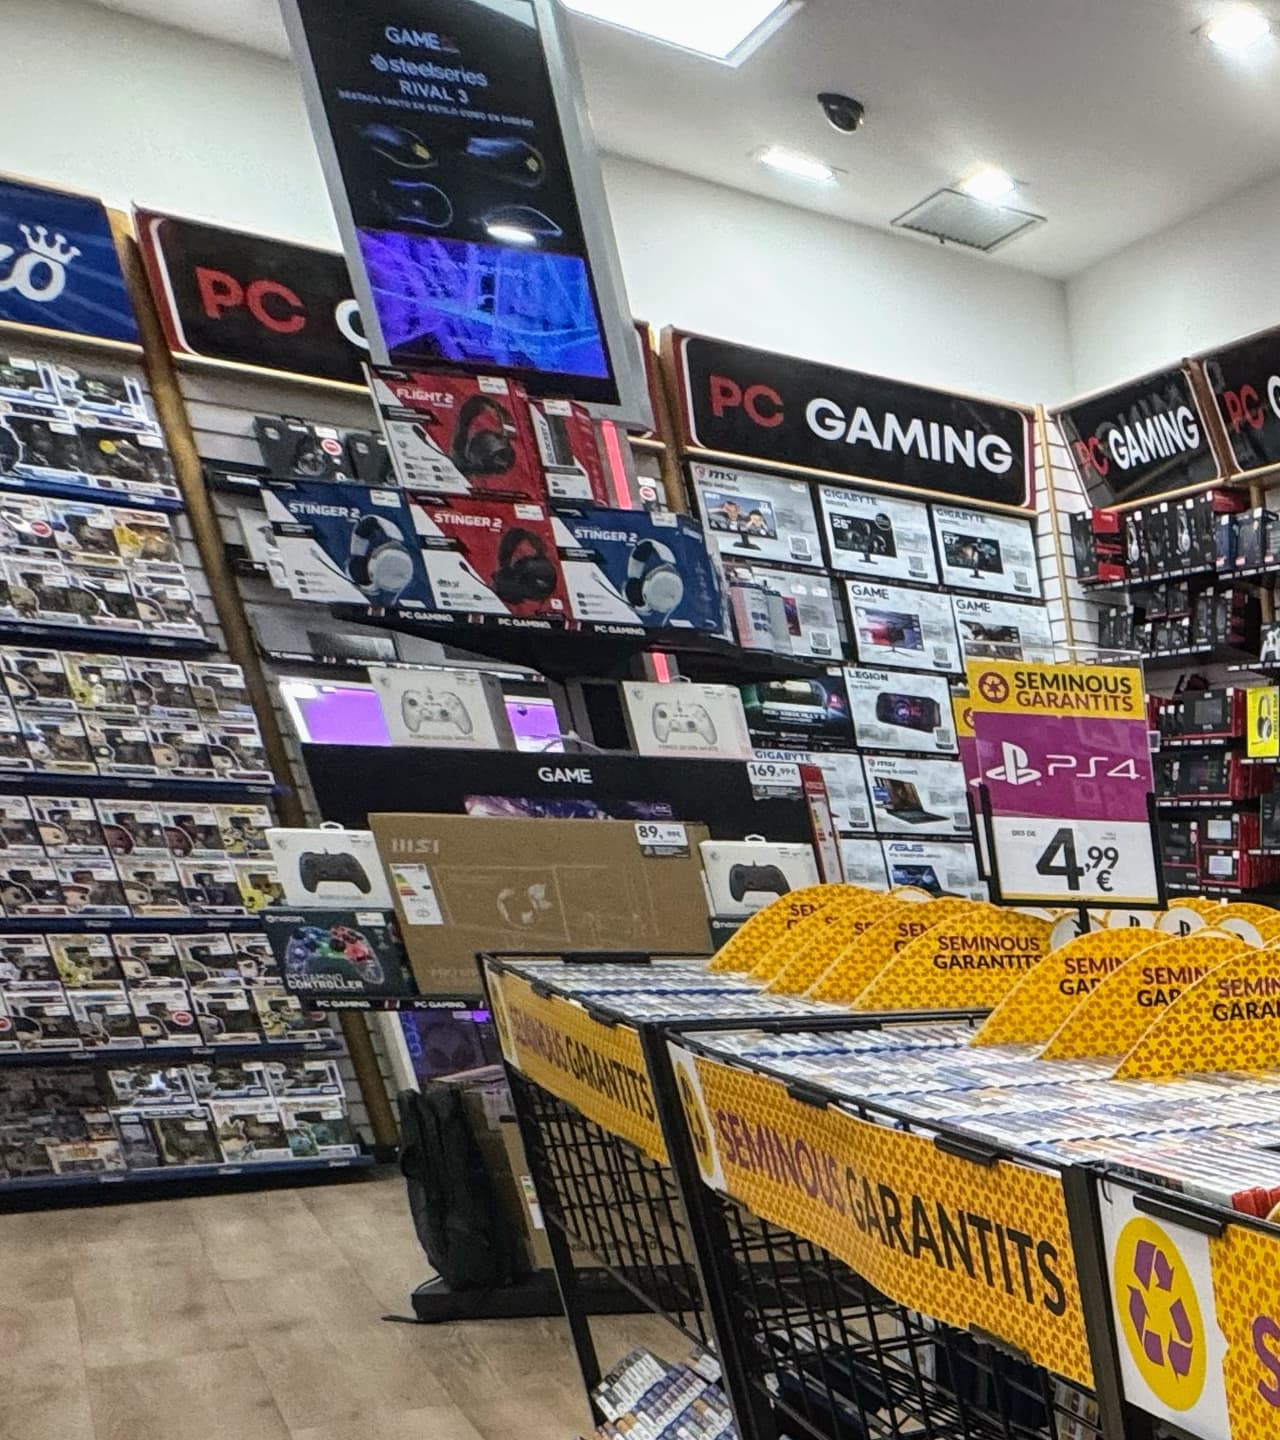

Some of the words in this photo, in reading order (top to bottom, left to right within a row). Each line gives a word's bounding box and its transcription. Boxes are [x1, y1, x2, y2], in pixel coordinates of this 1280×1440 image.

[385, 26, 441, 50] GAME
[389, 56, 488, 88] steelseries
[399, 79, 454, 101] RIVAL
[457, 89, 470, 105] 3
[195, 267, 305, 334] PC
[396, 387, 438, 403] FLIGHT
[440, 392, 454, 404] 2
[1222, 383, 1265, 434] PC
[709, 374, 785, 430] PC
[804, 396, 1013, 476] GAMING
[1075, 436, 1109, 479] PC
[1107, 404, 1200, 472] GAMING
[823, 487, 879, 507] GIGABYTE
[289, 502, 349, 519] STINGER
[350, 507, 361, 519] 2
[434, 511, 491, 528] STINGER
[491, 517, 503, 529] 2
[574, 527, 627, 543] STINGER
[627, 532, 639, 544] 2
[850, 583, 889, 601] GAME
[955, 598, 993, 614] GAME
[848, 668, 889, 683] LEGION
[1014, 671, 1132, 696] SEMINOUS
[1015, 690, 1134, 713] GARANTITS
[754, 749, 813, 763] GIGABYTE
[537, 766, 593, 786] GAME
[1046, 754, 1142, 780] PS4
[1036, 828, 1120, 892] 4,99
[1096, 870, 1114, 893] €
[938, 934, 1040, 953] SEMINOUS
[932, 953, 1043, 971] GARANTITS
[714, 1106, 847, 1216] SEMINOUS
[842, 1165, 1068, 1318] GARANTITS
